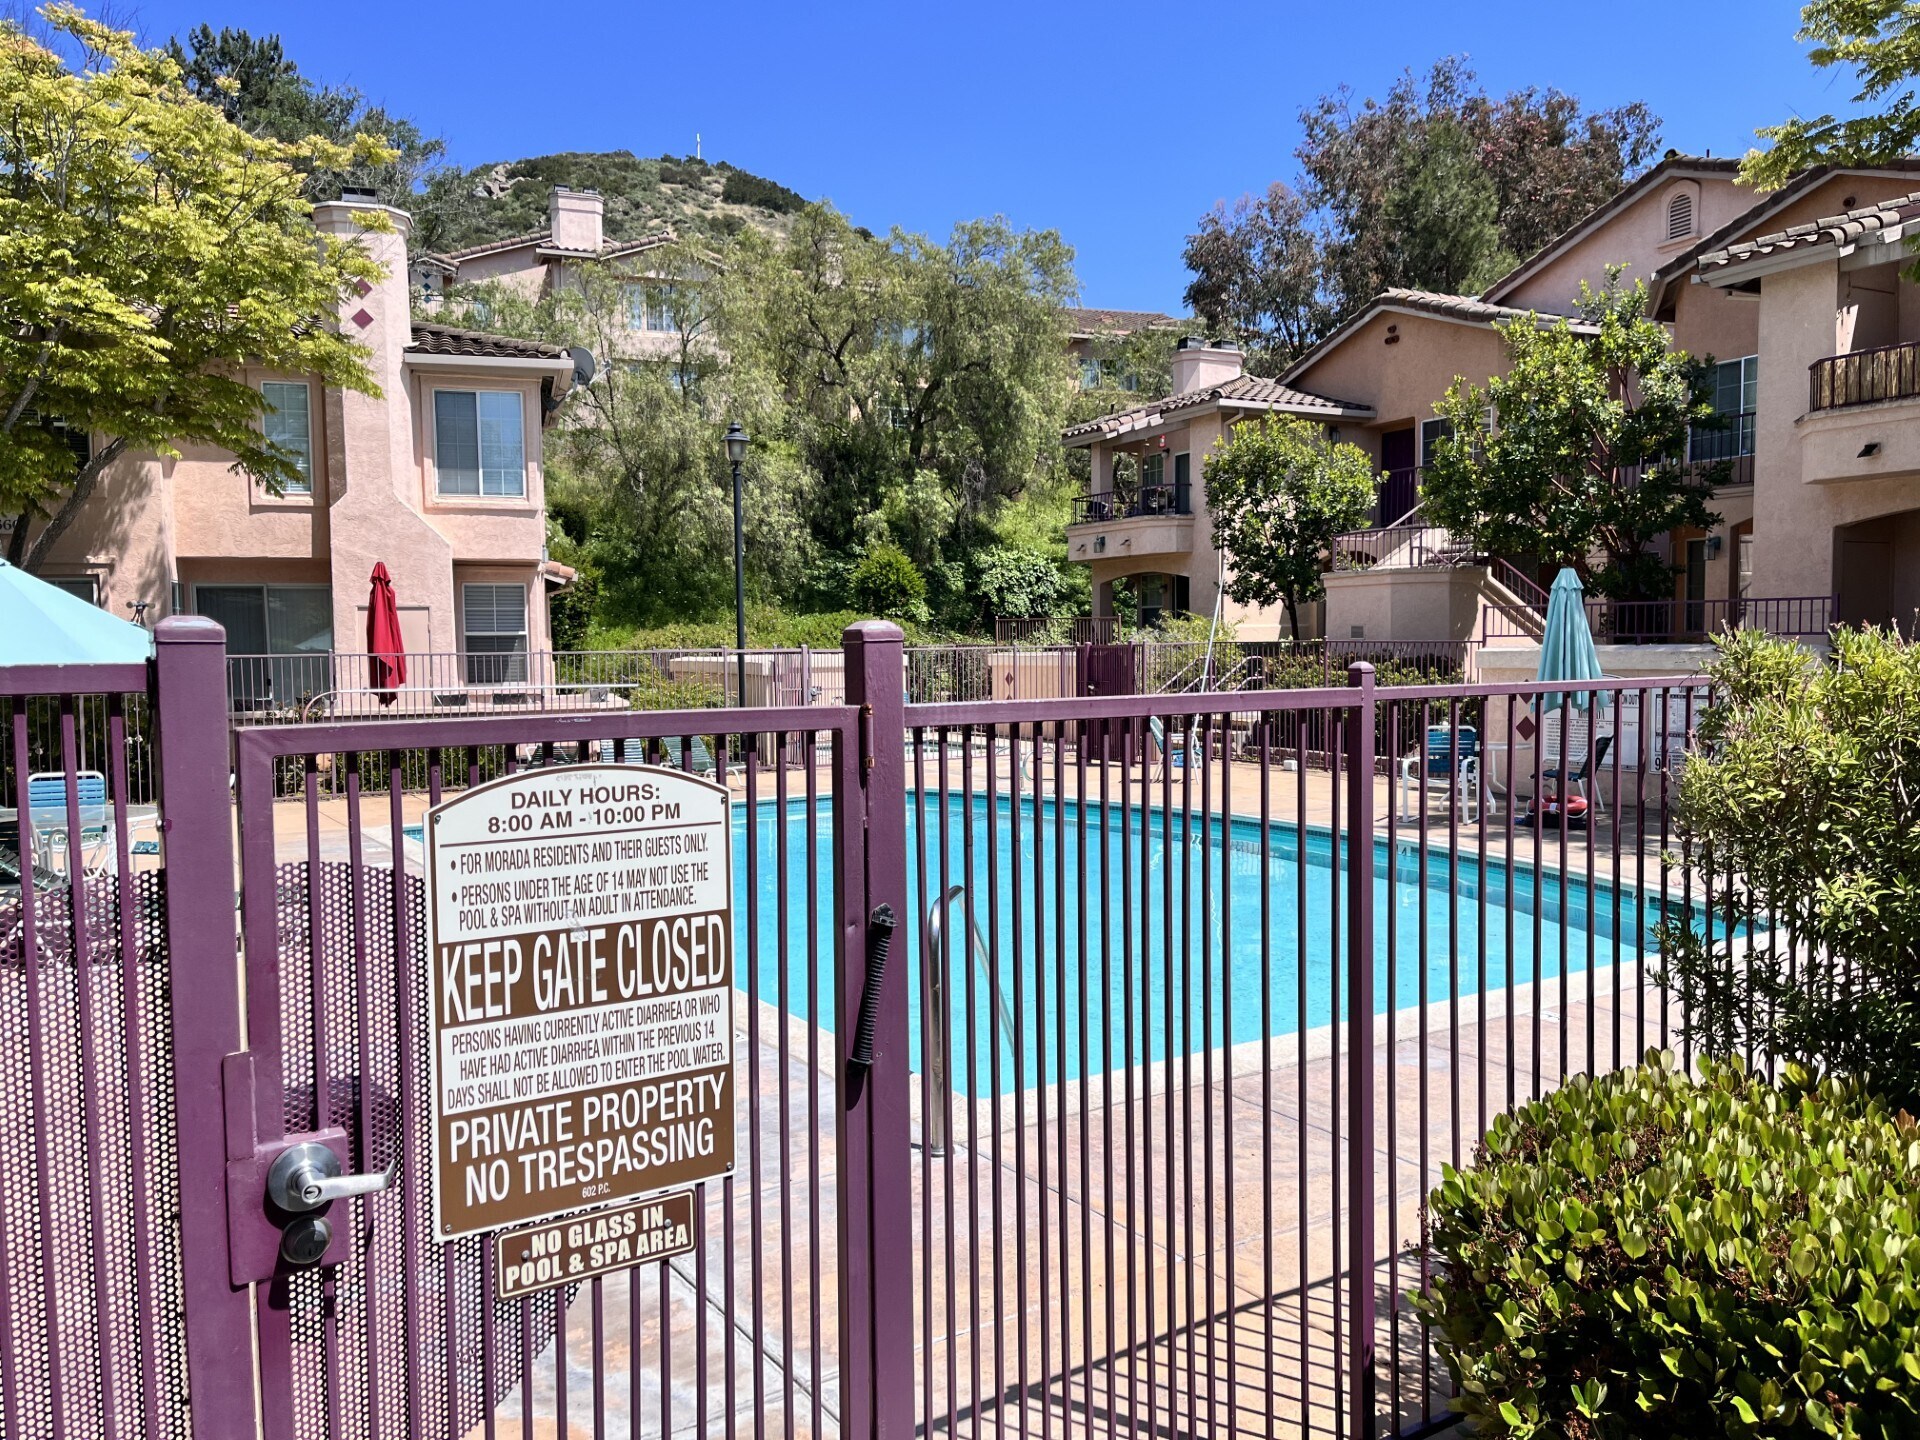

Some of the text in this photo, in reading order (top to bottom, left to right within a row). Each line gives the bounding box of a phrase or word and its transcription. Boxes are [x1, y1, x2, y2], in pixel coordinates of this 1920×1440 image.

[488, 814, 532, 833] 8:00
[540, 811, 572, 829] AM
[593, 806, 645, 825] 10:00
[652, 803, 680, 821] PM
[511, 784, 660, 809] DAILY HOURS:
[460, 833, 708, 875] FOR MORADA RESIDENTS AND THEIR GUESTS ONLY.
[459, 885, 697, 931] POOL & SPA WITHOUT AN ADULT IN ATTENDANCE.
[461, 862, 709, 907] PERSONS UNDER THE AGE OF 14 MAY NOT USE THE
[442, 914, 726, 1025] KEEP GATE CLOSED
[452, 994, 720, 1055] PERSONS HAVING CURRENTLY ACTIVE DIARRHEA OR WHO
[460, 1019, 715, 1081] HAVE HAD ACTIVE DIARRHEA WITHIN THE PREVIOUS 14
[448, 1042, 725, 1109] DAYS SHALL NOT BE ALLOWED TO ENTER THE POOL WATER.
[450, 1072, 726, 1163] PRIVATE PROPERTY
[466, 1117, 713, 1207] NO TRESPASSING
[582, 1182, 611, 1198] 602 P.C.
[506, 1224, 689, 1290] POOL & SPA AREA
[532, 1205, 663, 1258] NO GLASS IN
